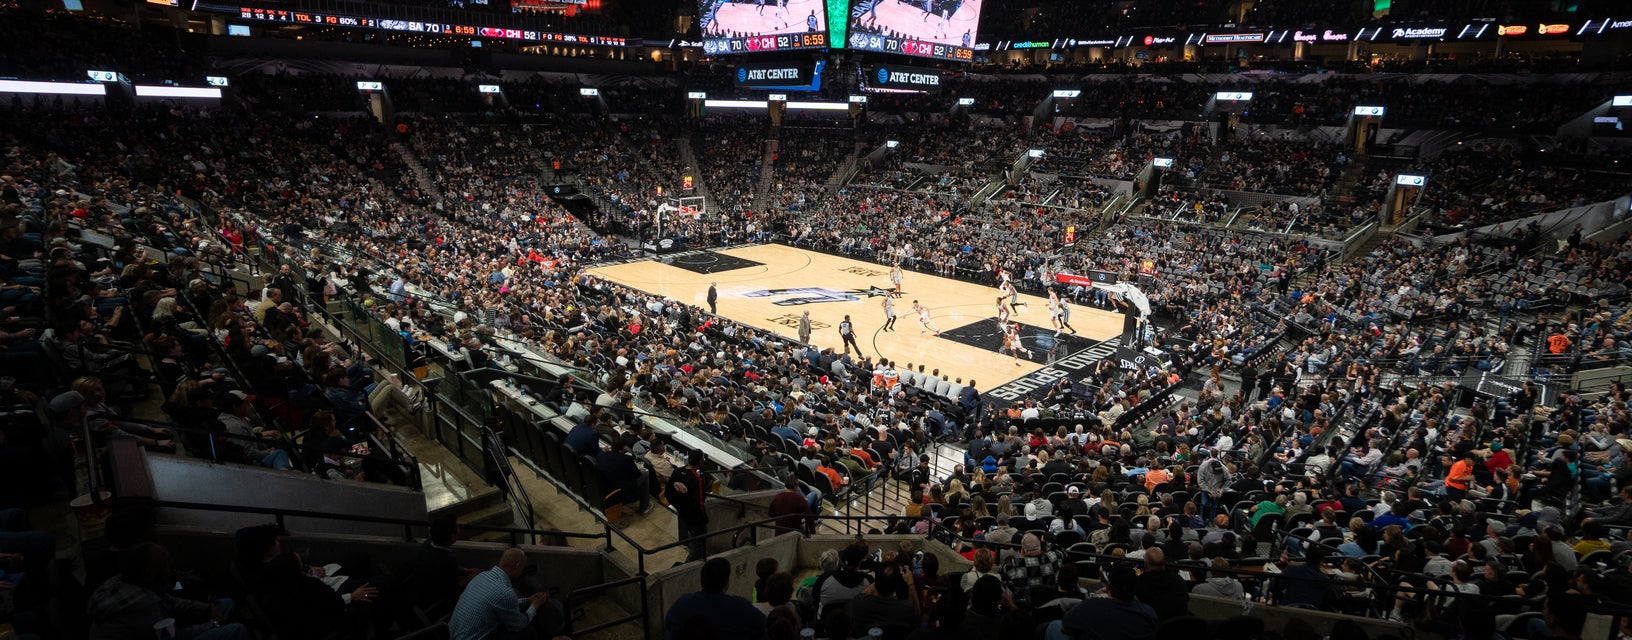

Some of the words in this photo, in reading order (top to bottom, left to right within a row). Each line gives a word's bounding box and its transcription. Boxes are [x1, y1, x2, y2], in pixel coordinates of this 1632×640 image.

[296, 14, 311, 22] TOL
[1611, 20, 1632, 28] Amer
[408, 22, 422, 30] SA
[424, 24, 439, 32] 70
[455, 26, 474, 34] 6:59
[1405, 28, 1447, 36] Academy
[506, 30, 520, 38] CHI
[524, 32, 536, 40] 52
[718, 42, 728, 50] SA
[732, 40, 742, 50] 70
[761, 38, 775, 48] CHI
[778, 36, 788, 46] 52
[804, 34, 824, 46] 6:59
[870, 37, 881, 48] SA
[886, 40, 898, 50] 70
[920, 43, 932, 54] CHI
[934, 46, 944, 56] 52
[956, 48, 972, 59] 6:59
[748, 70, 766, 80] AT&T
[767, 68, 798, 79] CENTER
[890, 72, 909, 82] AT&T
[910, 73, 939, 84] CENTER
[1554, 339, 1568, 347] 173
[989, 368, 1069, 400] SPURS
